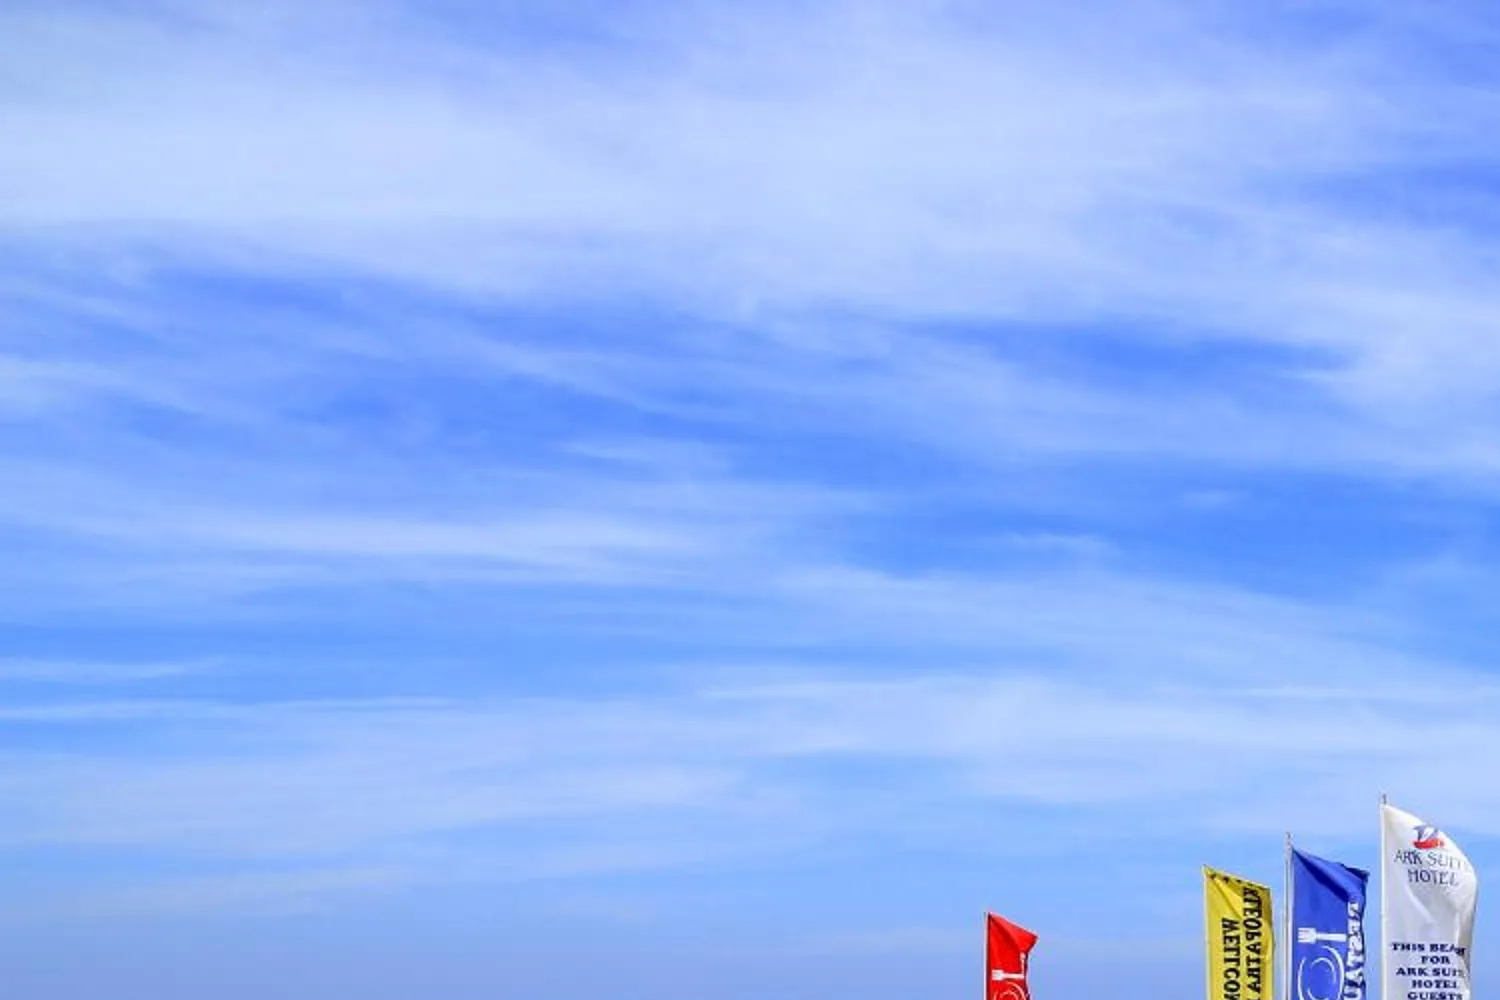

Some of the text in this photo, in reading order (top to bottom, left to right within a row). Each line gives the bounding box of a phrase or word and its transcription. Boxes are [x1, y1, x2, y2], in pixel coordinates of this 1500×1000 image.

[1393, 848, 1423, 866] ARK
[1391, 942, 1426, 952] THIS
[1420, 955, 1451, 965] FOR
[1395, 966, 1429, 977] ARK
[1411, 979, 1458, 989] HOTEL
